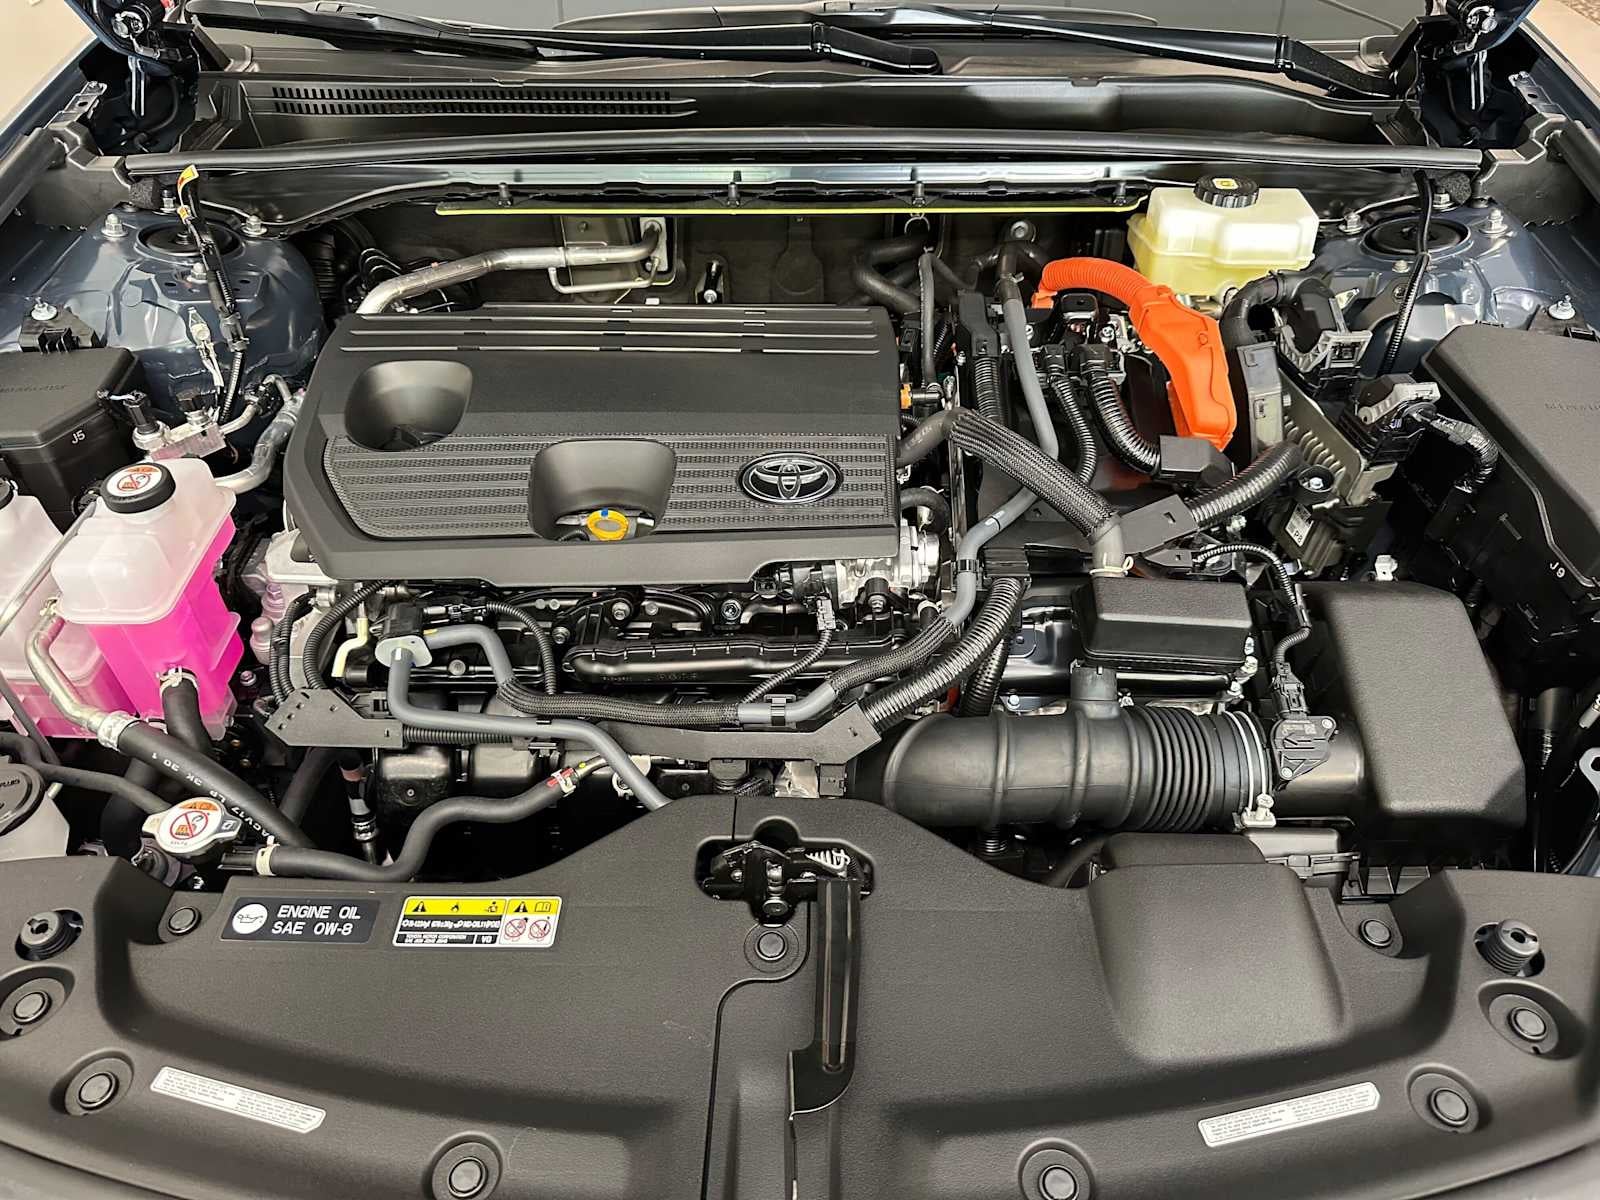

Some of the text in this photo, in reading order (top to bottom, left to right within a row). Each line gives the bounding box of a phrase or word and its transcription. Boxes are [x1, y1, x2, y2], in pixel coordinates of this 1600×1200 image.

[71, 429, 86, 445] J5
[1549, 561, 1566, 578] J9
[209, 790, 227, 804] LP
[231, 806, 273, 837] ACV17
[277, 905, 361, 920] ENGINE OIL
[271, 921, 306, 935] SAE
